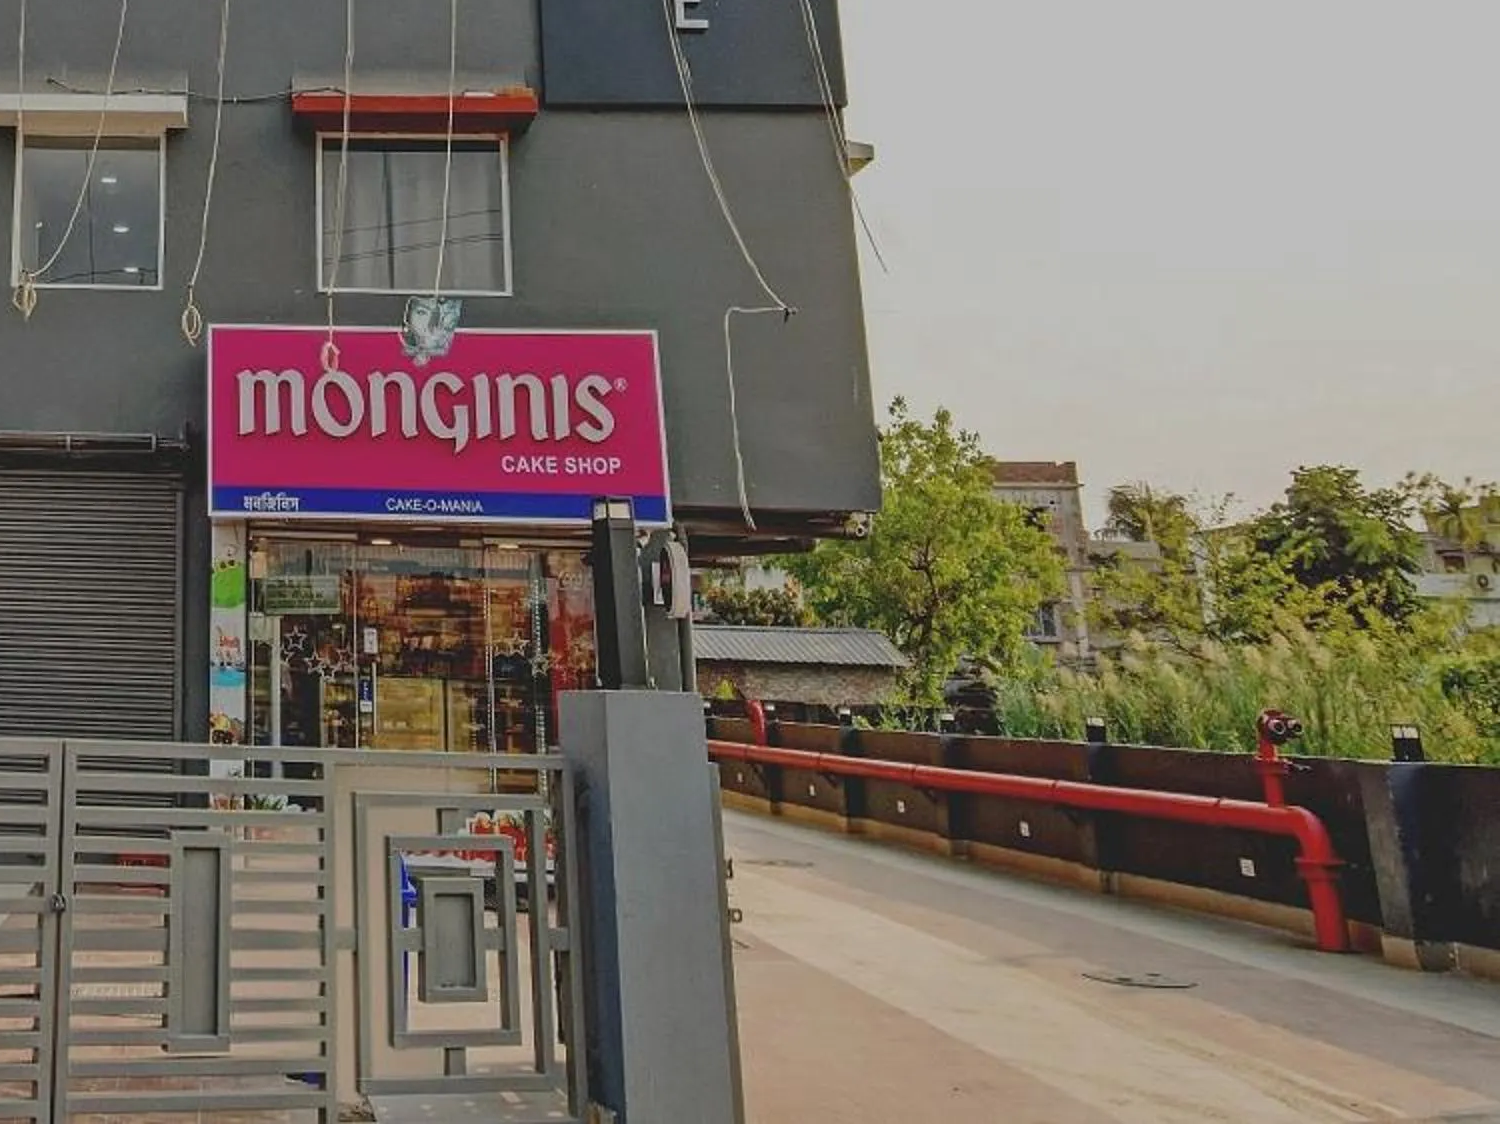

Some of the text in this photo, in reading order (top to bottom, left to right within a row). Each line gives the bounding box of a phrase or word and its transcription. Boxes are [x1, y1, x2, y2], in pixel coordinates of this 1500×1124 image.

[501, 455, 622, 475] CAKE SHOP
[385, 497, 485, 514] CAKE-O-MANIA
